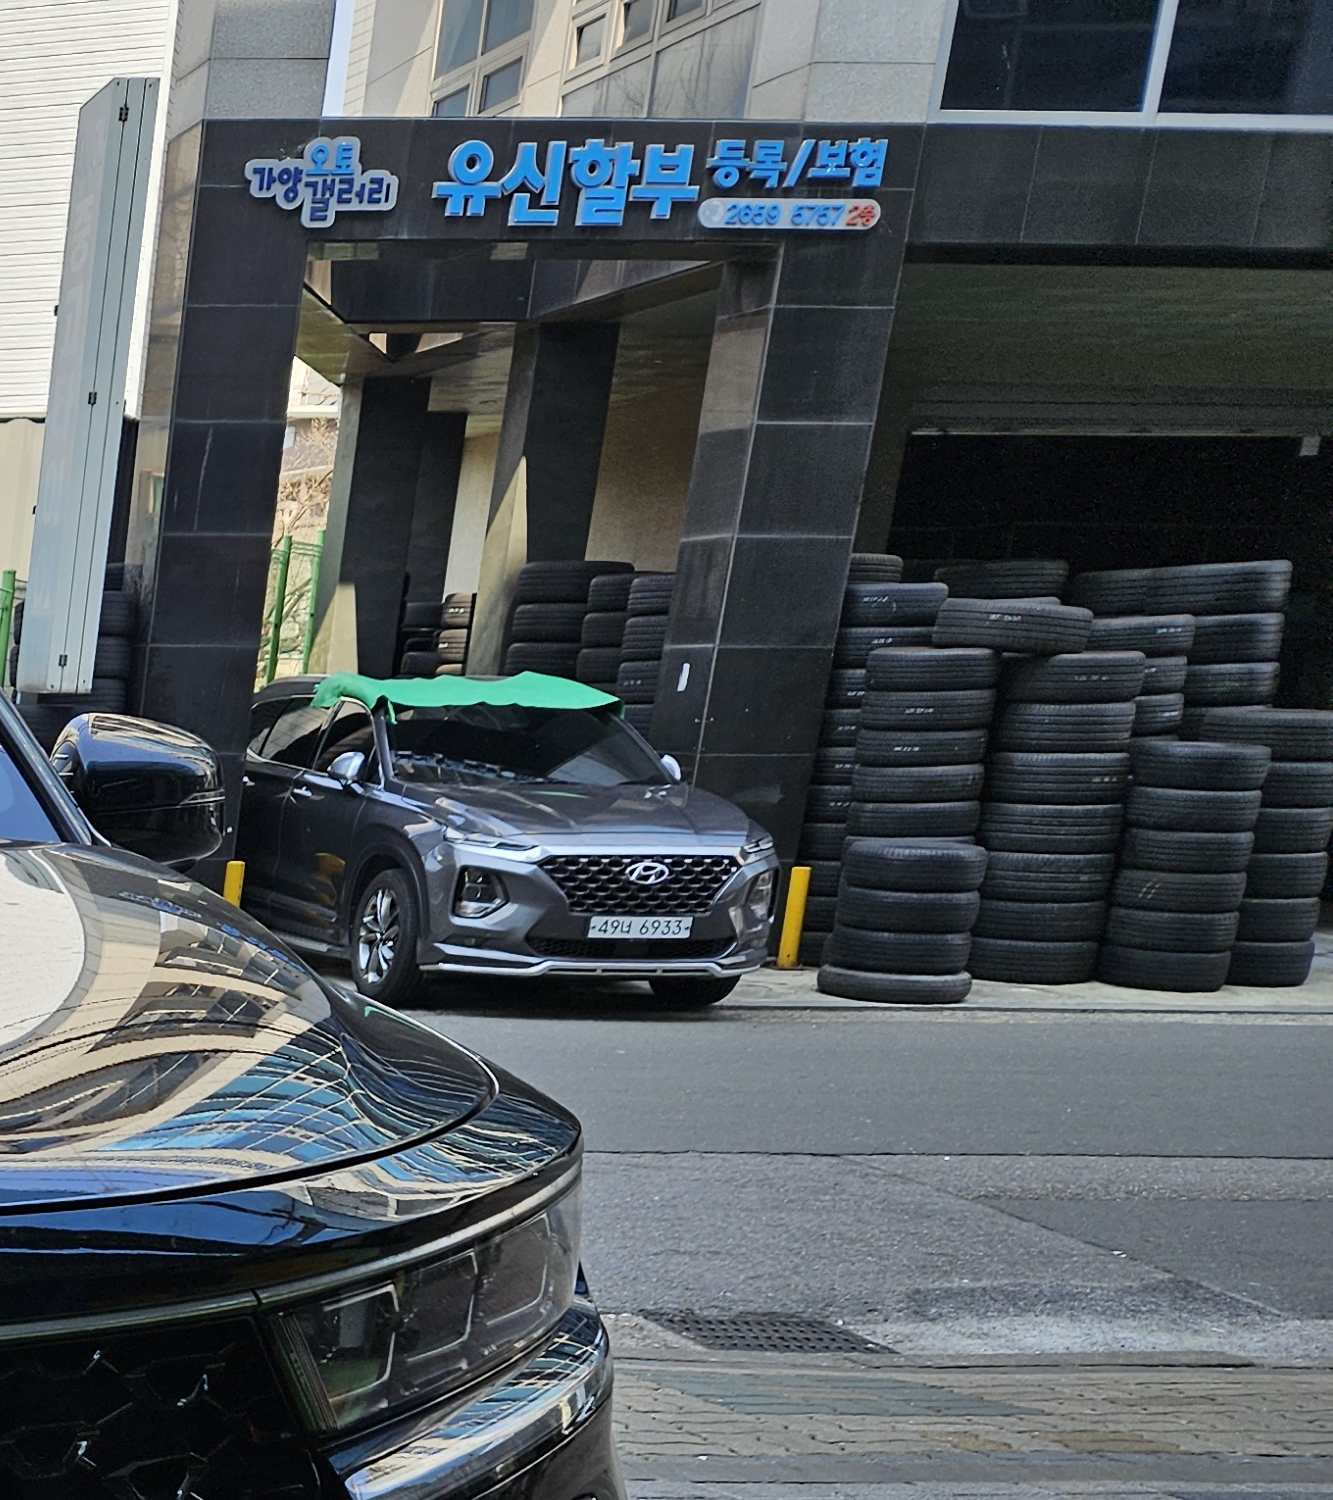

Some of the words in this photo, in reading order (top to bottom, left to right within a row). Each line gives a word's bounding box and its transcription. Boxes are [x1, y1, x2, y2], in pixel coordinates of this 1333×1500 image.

[306, 145, 355, 176] 오토
[706, 137, 889, 188] 등록/보험
[253, 167, 303, 202] 가양
[305, 177, 391, 221] 갤러리
[432, 138, 700, 226] 유신할부
[725, 203, 782, 225] 2659
[791, 204, 845, 225] 5757
[639, 919, 682, 935] 6933
